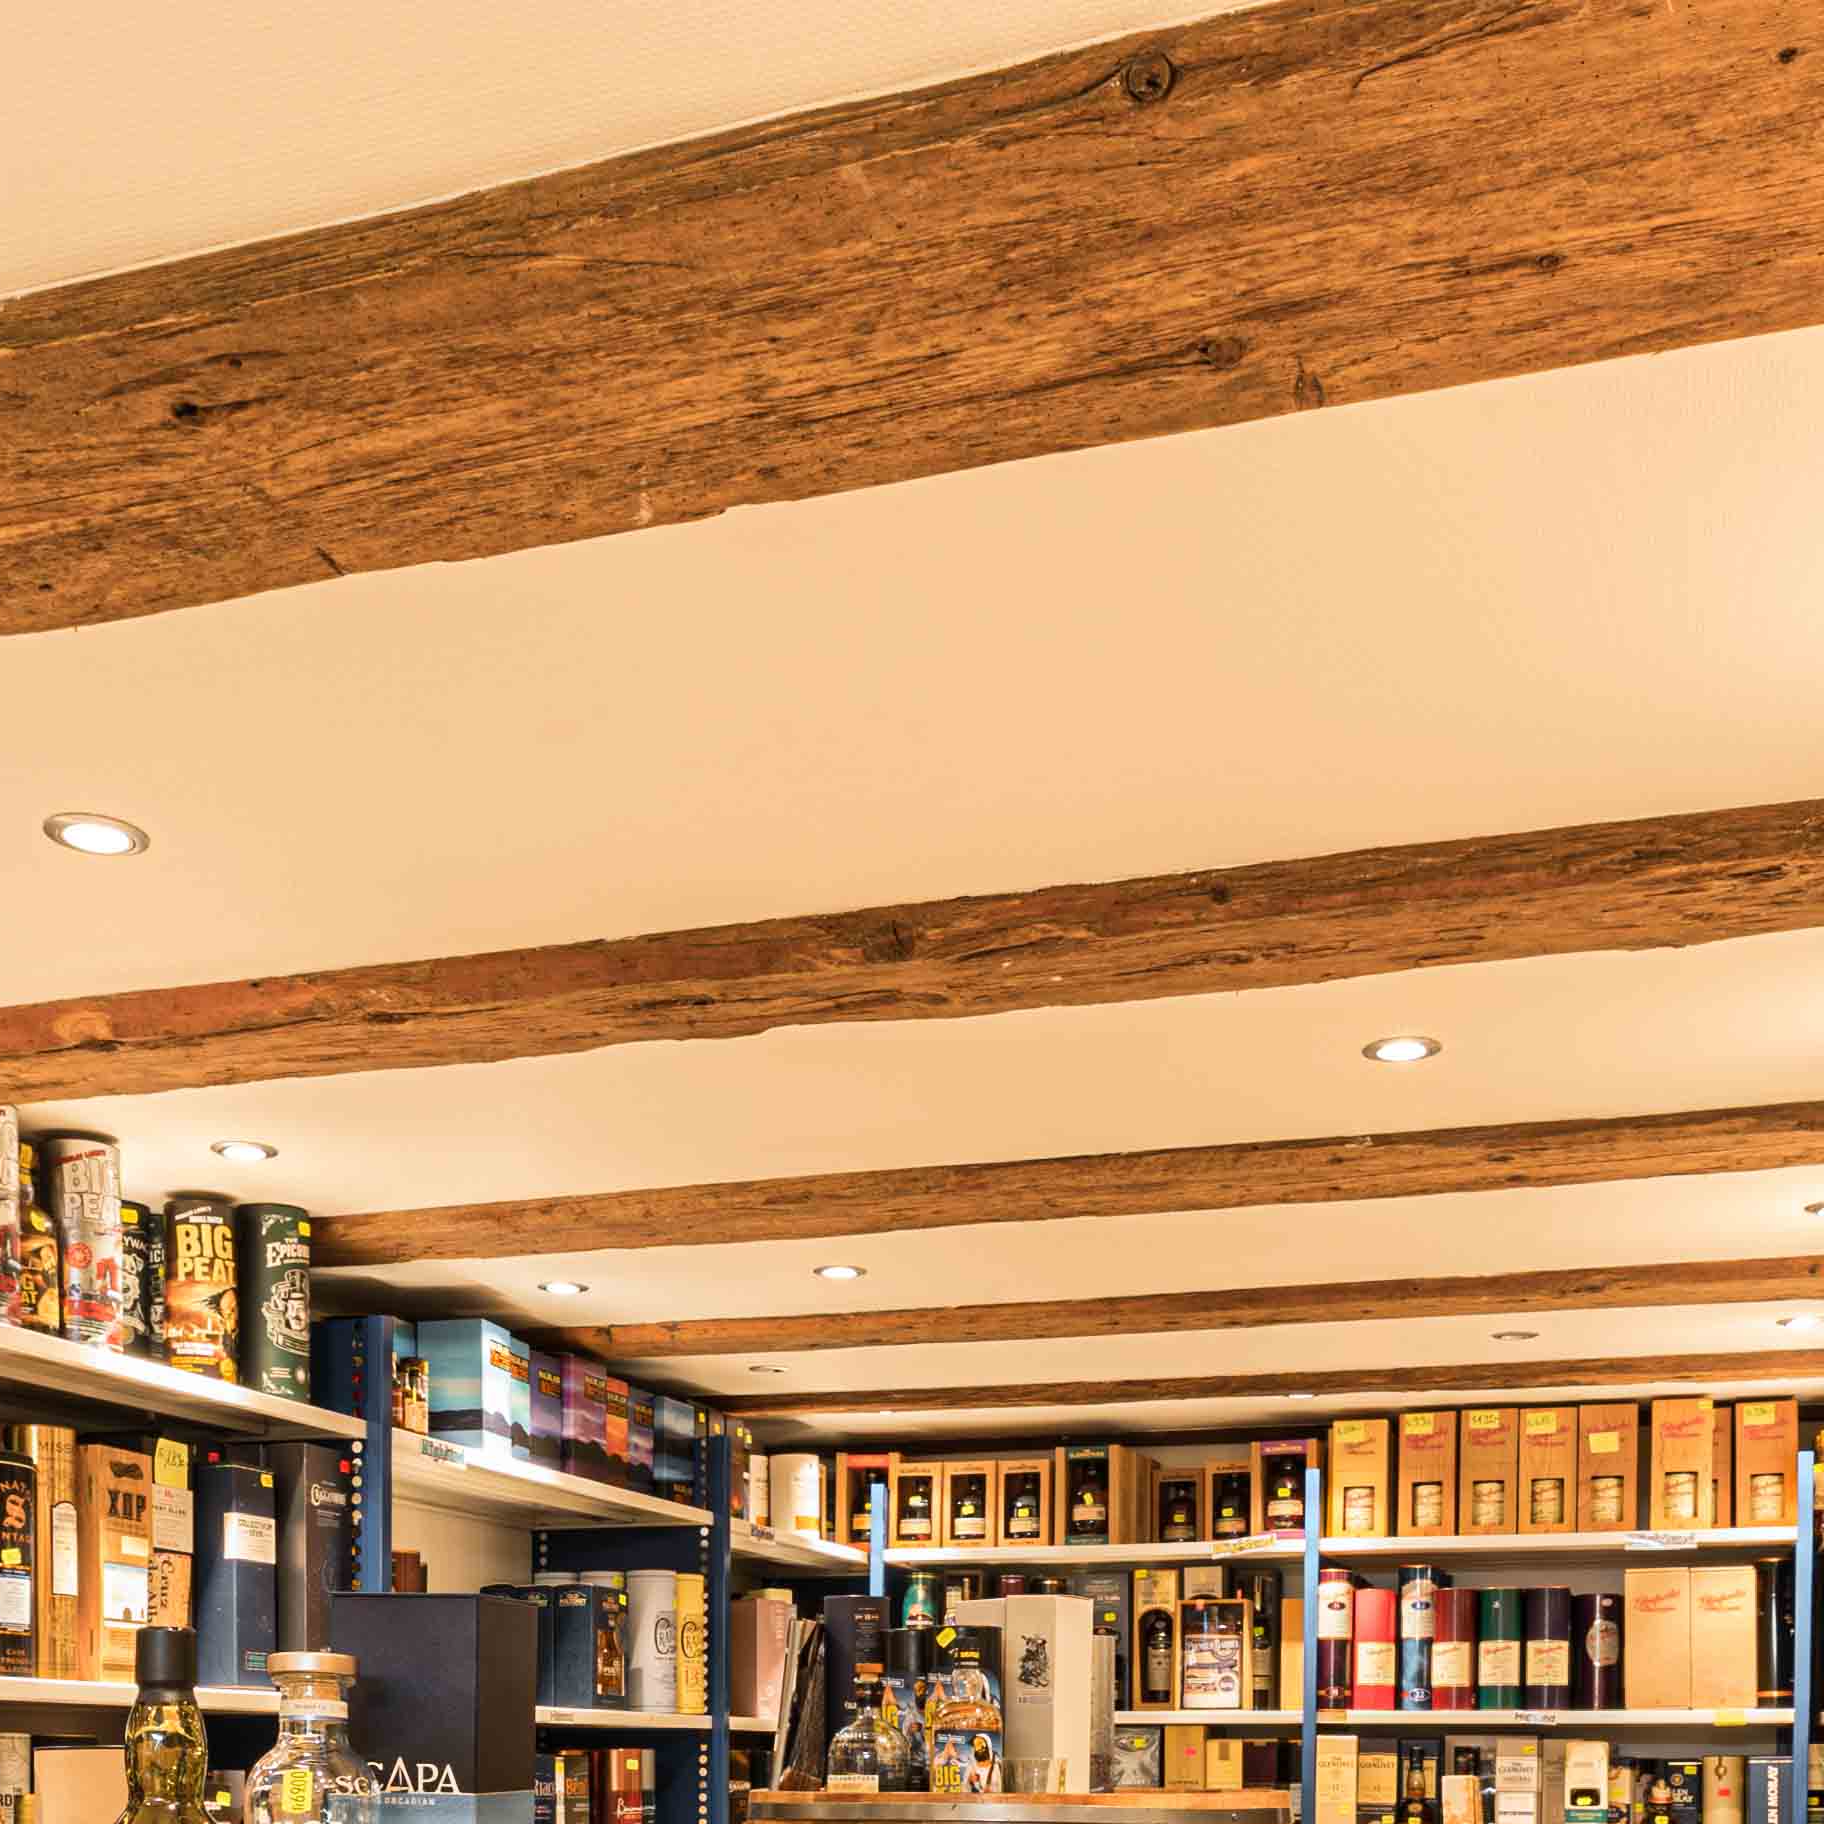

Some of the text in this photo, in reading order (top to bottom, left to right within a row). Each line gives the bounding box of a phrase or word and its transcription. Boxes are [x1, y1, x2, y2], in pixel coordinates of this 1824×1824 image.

[176, 1223, 233, 1259] BIG
[177, 1257, 236, 1283] PEAT
[934, 1765, 962, 1786] BIG
